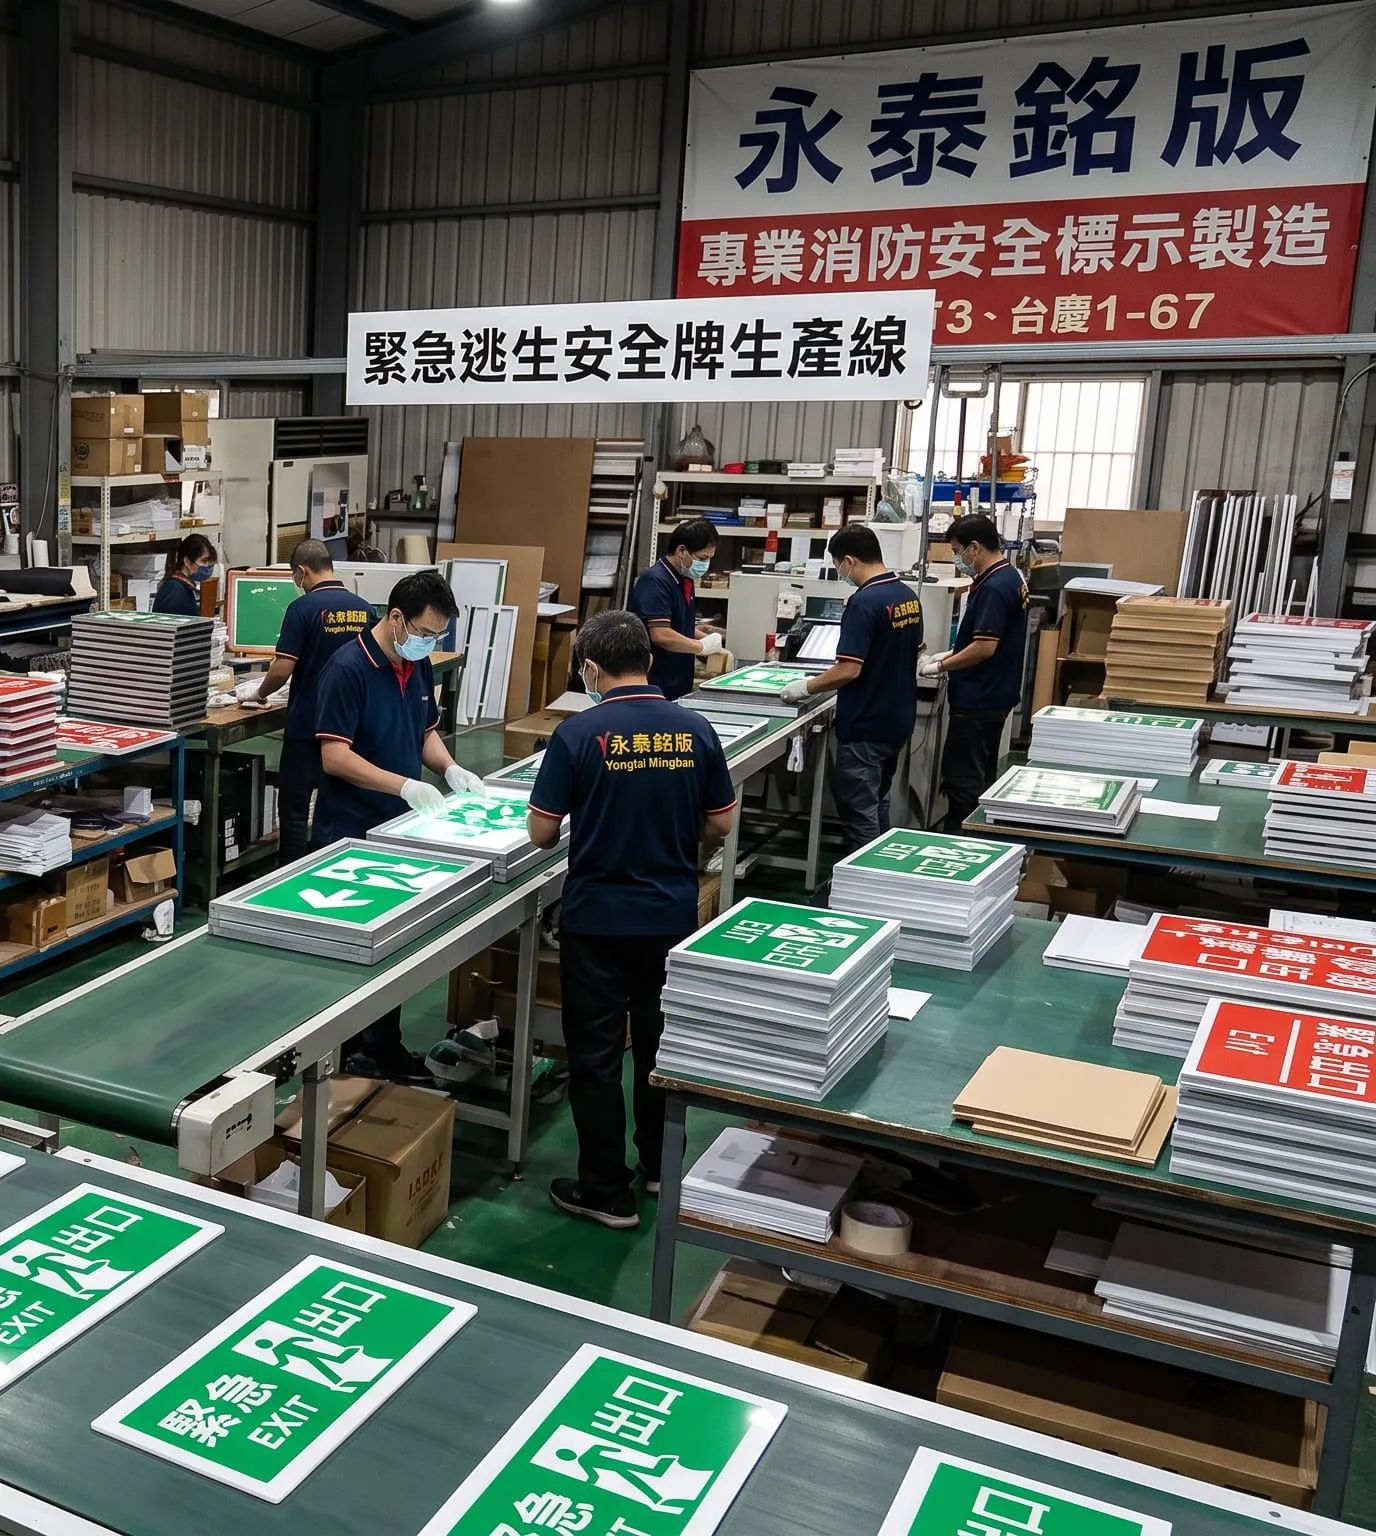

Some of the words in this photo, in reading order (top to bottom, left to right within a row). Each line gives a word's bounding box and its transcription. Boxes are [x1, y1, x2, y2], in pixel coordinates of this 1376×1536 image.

[734, 37, 1311, 194] 永泰銘版
[696, 202, 1332, 288] 專業消防安全標示製造
[362, 314, 908, 386] 緊急逃生安全牌生產線
[605, 758, 647, 772] Yongtai
[649, 757, 695, 770] Mingban
[610, 732, 694, 756] 永泰銘版
[50, 1205, 144, 1253] 出口
[157, 1373, 279, 1448] 緊急
[292, 1281, 388, 1338] 出口
[247, 1394, 320, 1450] EXIT
[590, 1375, 684, 1446] 出口
